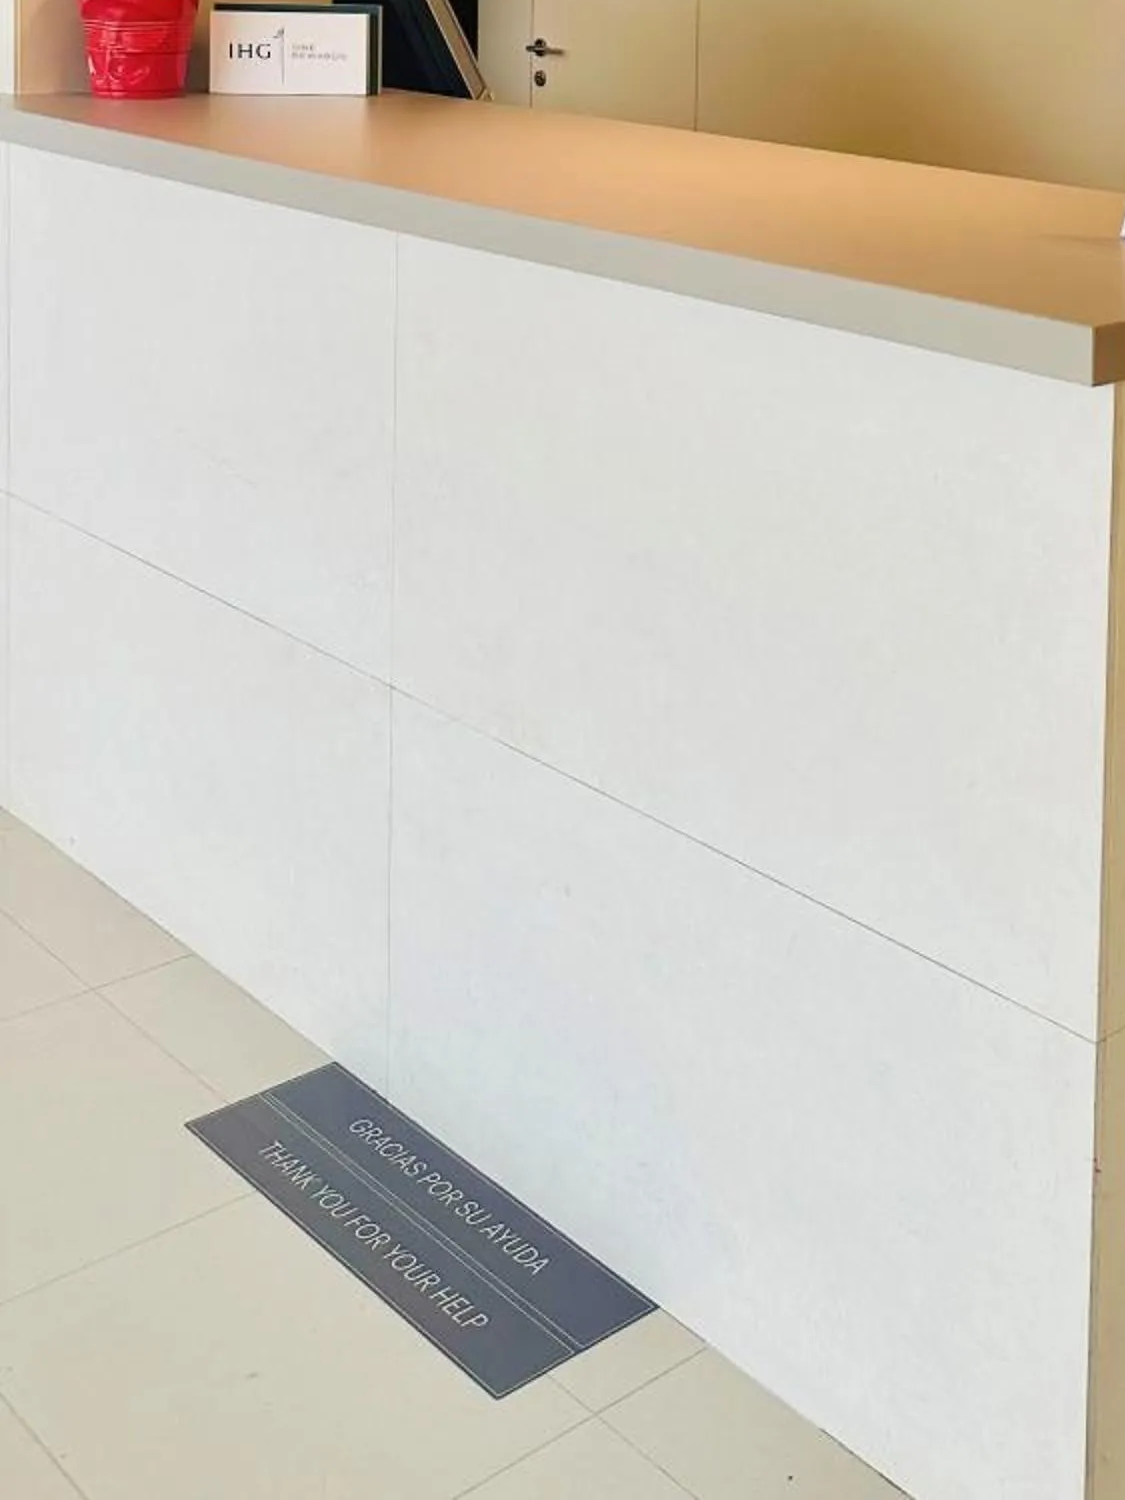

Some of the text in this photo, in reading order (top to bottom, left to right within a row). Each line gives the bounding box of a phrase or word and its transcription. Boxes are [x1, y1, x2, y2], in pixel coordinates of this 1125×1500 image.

[229, 42, 271, 60] IHG
[259, 1140, 489, 1329] THANK YOU FOR YOUR HELP
[349, 1119, 550, 1275] GRACIAS POR SU AYUDA
